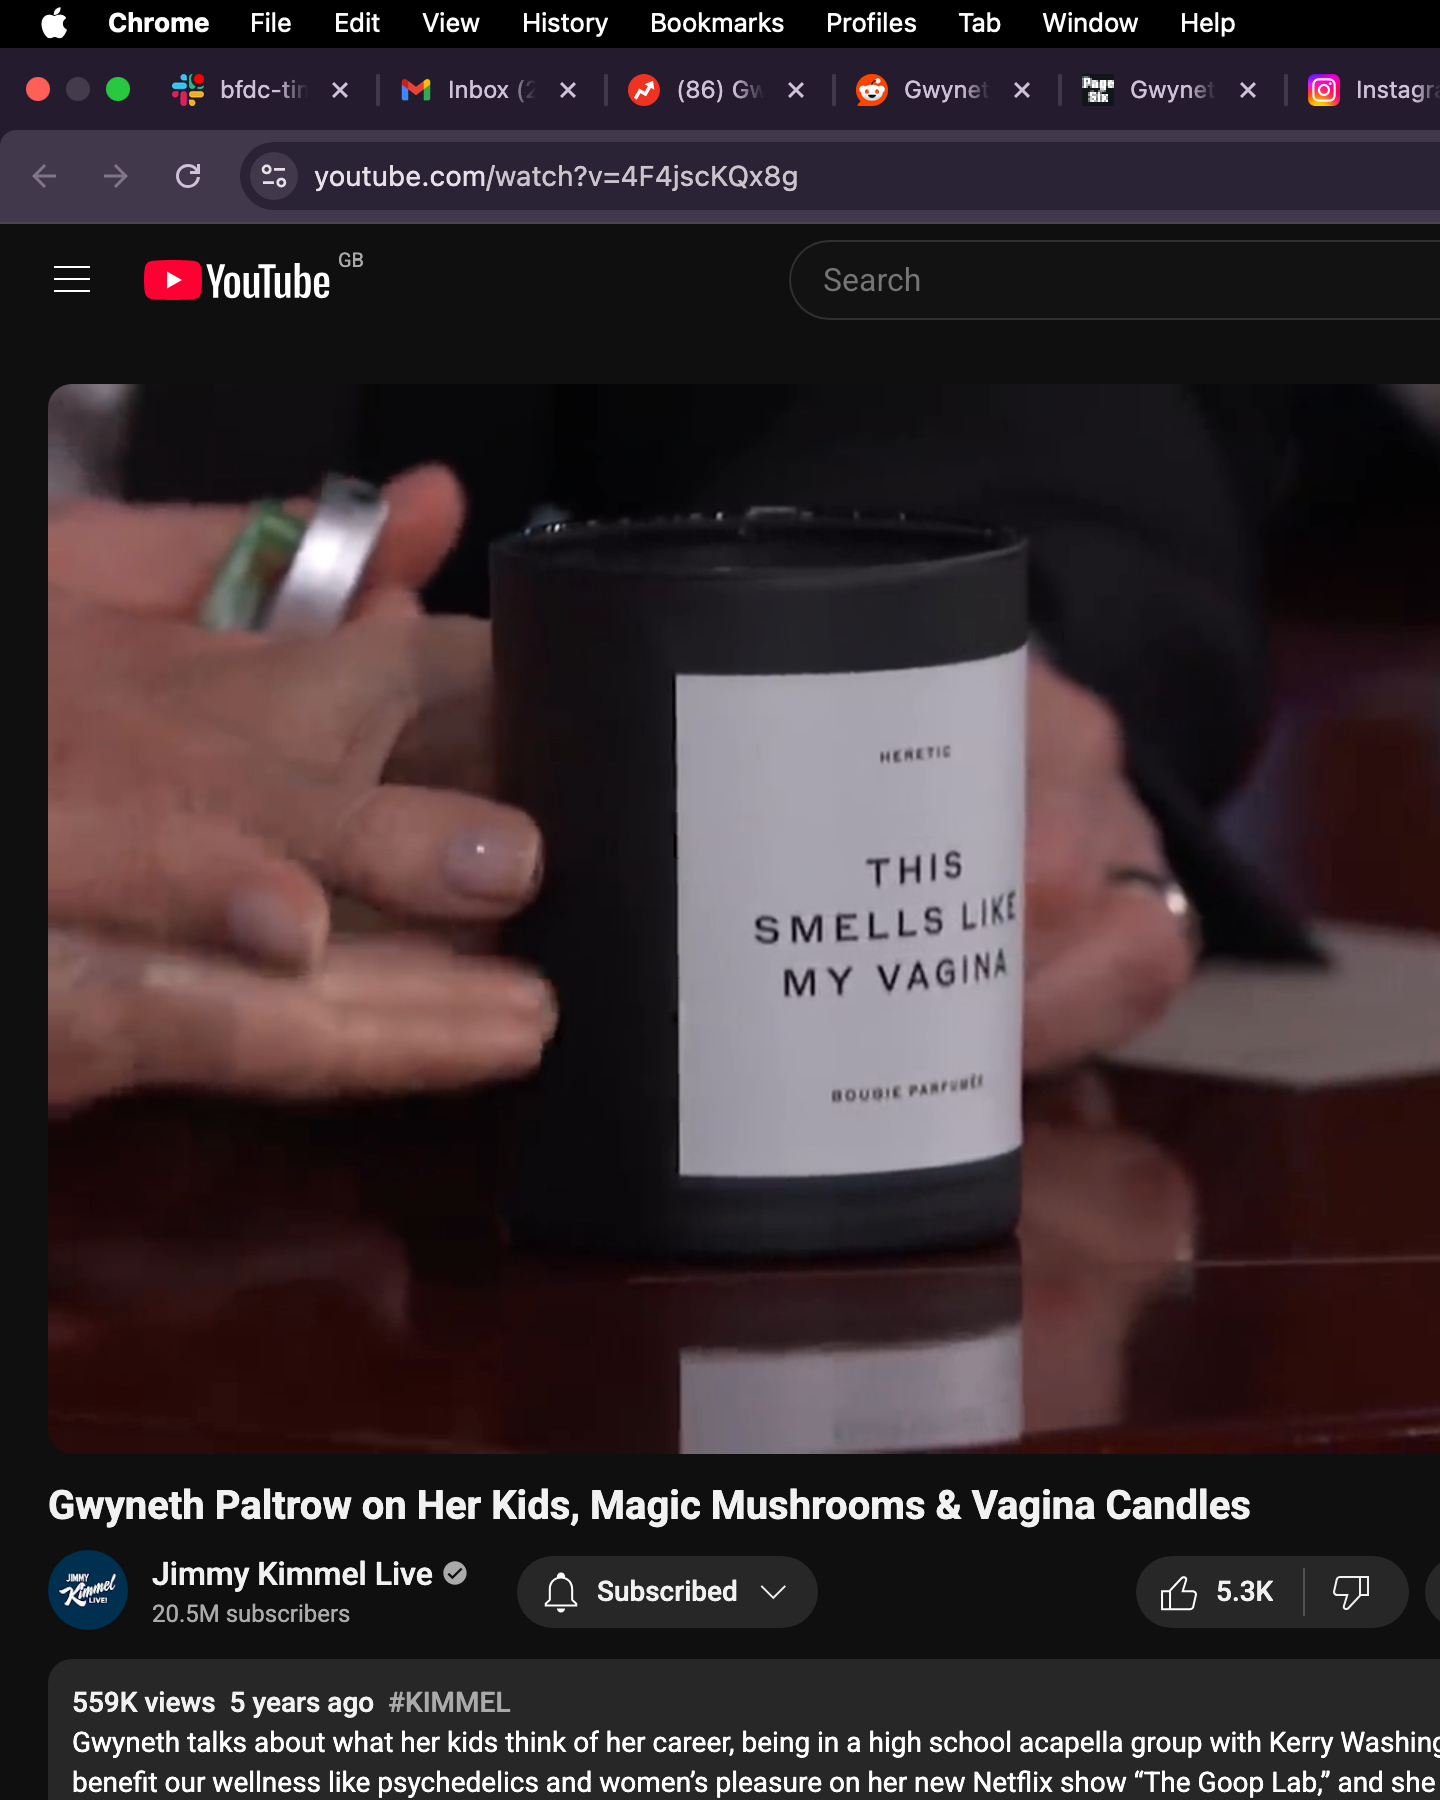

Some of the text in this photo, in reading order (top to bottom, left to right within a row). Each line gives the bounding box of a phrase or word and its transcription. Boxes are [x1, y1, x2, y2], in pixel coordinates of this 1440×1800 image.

[108, 11, 1236, 38] Chrome File Edit View History Bookmarks Profiles Tab Window Help
[449, 79, 509, 99] Inbox
[678, 79, 723, 103] (86)
[314, 164, 798, 192] youtube.com/watch?v=4F4jscKQx8g
[338, 251, 364, 268] GB
[206, 262, 331, 299] YouTube
[824, 266, 920, 292] Search
[880, 745, 951, 764] HERETIC
[866, 851, 963, 887] THIS
[755, 890, 1016, 944] SMELLS LIKE
[784, 949, 1007, 998] MY VAGINA
[831, 1086, 902, 1103] BOUGIE
[48, 1487, 1251, 1529] Gwyneth Paltrow on Her Kids, Magic Mushrooms & Vagina Candles
[151, 1559, 433, 1593] Jimmy Kimmel Live
[597, 1578, 738, 1603] Subscribed
[1216, 1579, 1274, 1603] 5.3K
[152, 1602, 351, 1623] 20.5M subscribers
[72, 1690, 511, 1719] 559K views 5 years ago #KIMMEL
[72, 1729, 861, 1759] Gwyneth talks about what her kids think of her career, being in a
